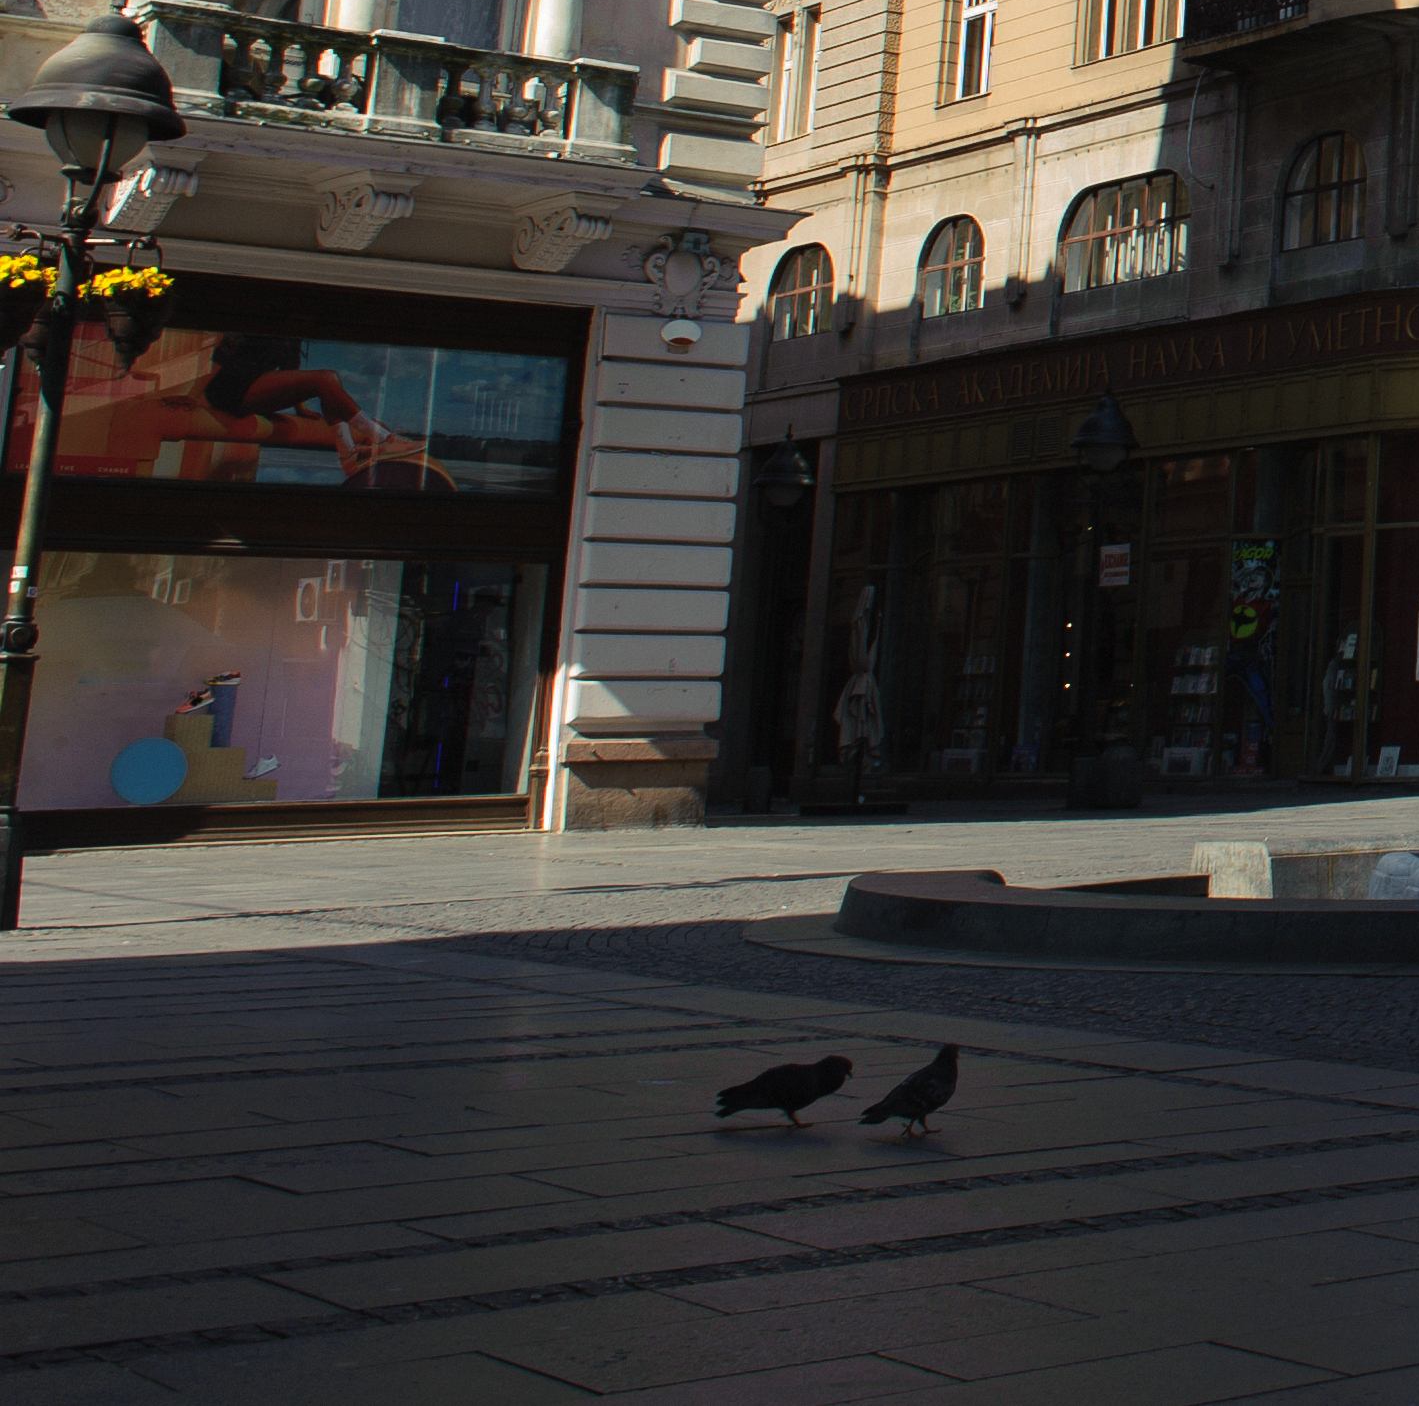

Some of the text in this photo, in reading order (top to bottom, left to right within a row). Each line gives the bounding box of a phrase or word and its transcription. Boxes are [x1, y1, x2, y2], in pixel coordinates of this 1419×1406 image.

[845, 378, 939, 421] СРПСКА
[957, 352, 1110, 405] АКАДЕМИЈА
[1129, 333, 1225, 379] НАУКА
[1247, 324, 1267, 362] И
[98, 466, 129, 474] CHANGE
